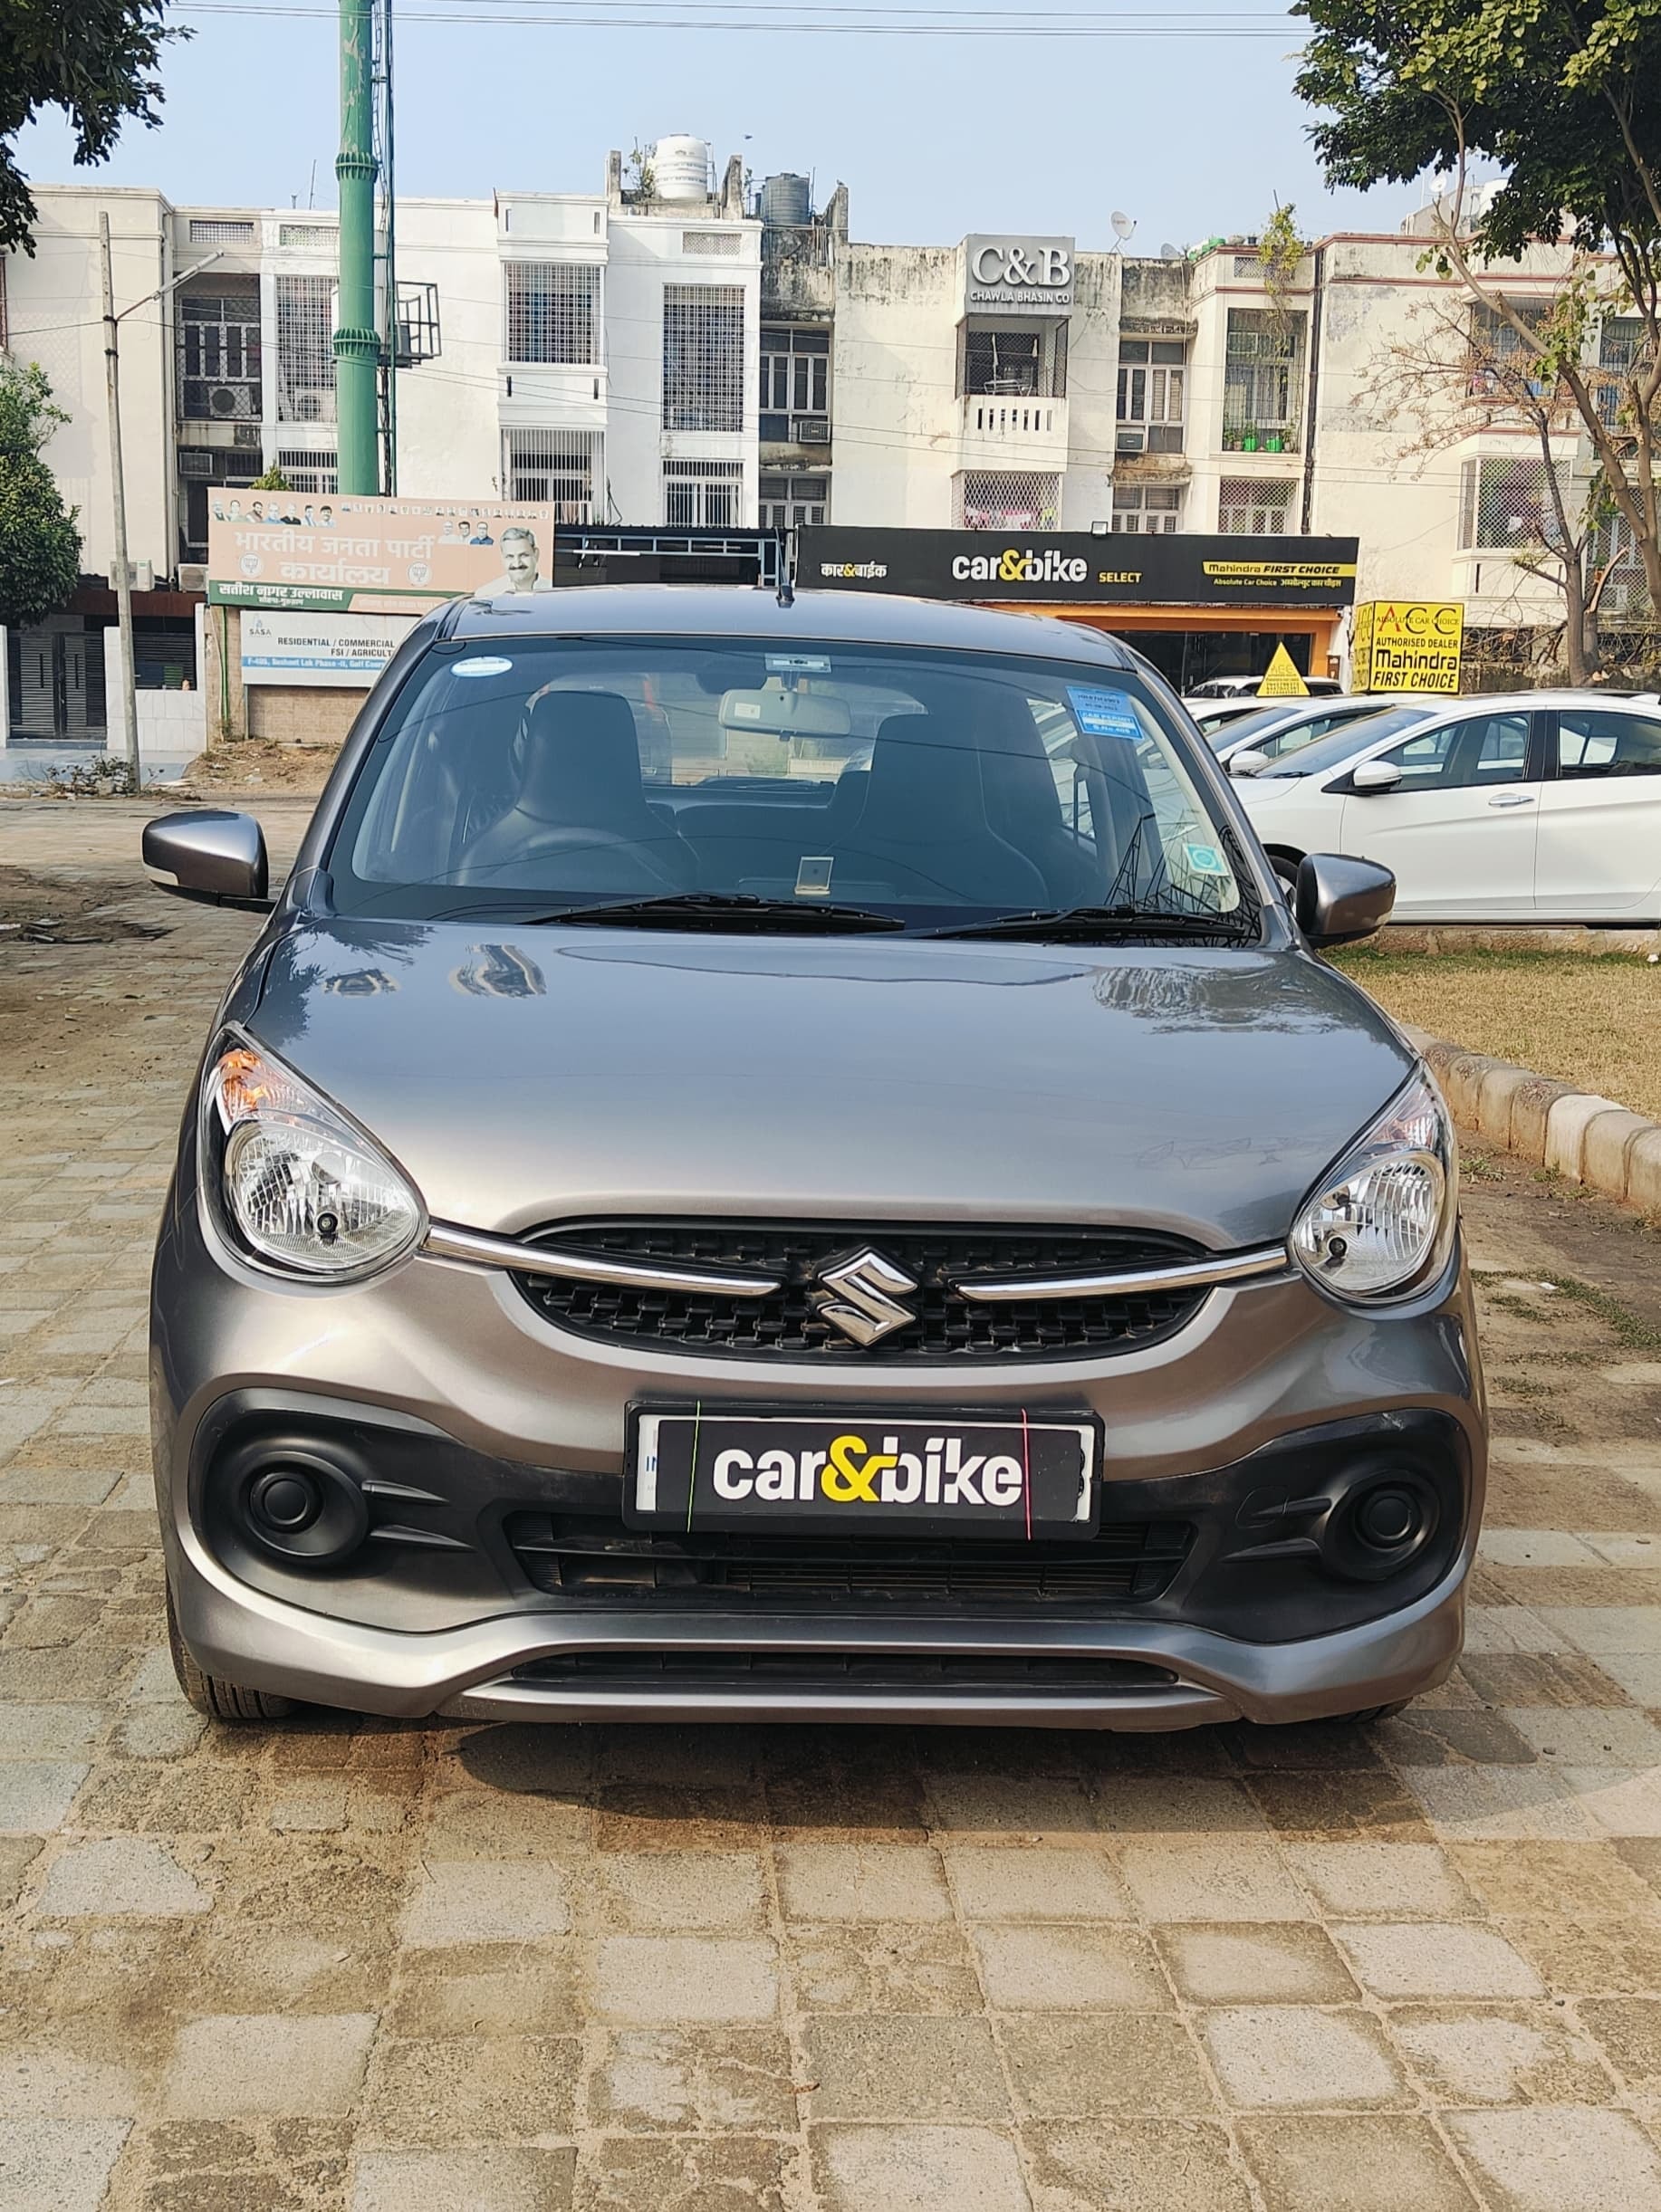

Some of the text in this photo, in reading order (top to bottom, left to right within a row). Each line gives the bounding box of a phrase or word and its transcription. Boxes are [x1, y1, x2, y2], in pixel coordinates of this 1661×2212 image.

[971, 246, 1071, 287] C&B
[970, 290, 1070, 304] CHAWLA BHASIN CO
[234, 529, 436, 559] भारतीय जनता पार्टी
[279, 558, 390, 585] कार्यालय
[952, 549, 1088, 582] car&bike
[1208, 564, 1340, 574] Mahindra FIRST CHOICE
[1099, 571, 1142, 583] SELECT
[1214, 578, 1243, 586] Absolute
[1255, 579, 1277, 587] Choice
[218, 581, 254, 595] सतीश
[1415, 617, 1429, 625] CAR
[1431, 618, 1459, 626] CHOICE
[277, 637, 331, 646] RESIDENTIAL
[338, 638, 396, 648] COMMERCIAL
[1376, 637, 1458, 649] AUTHORISED DEALER
[331, 647, 344, 656] FSI
[316, 659, 336, 667] Phase
[1375, 648, 1457, 670] Mahindra
[1373, 671, 1456, 688] FIRST CHOICE
[713, 1434, 1023, 1506] car&bike
